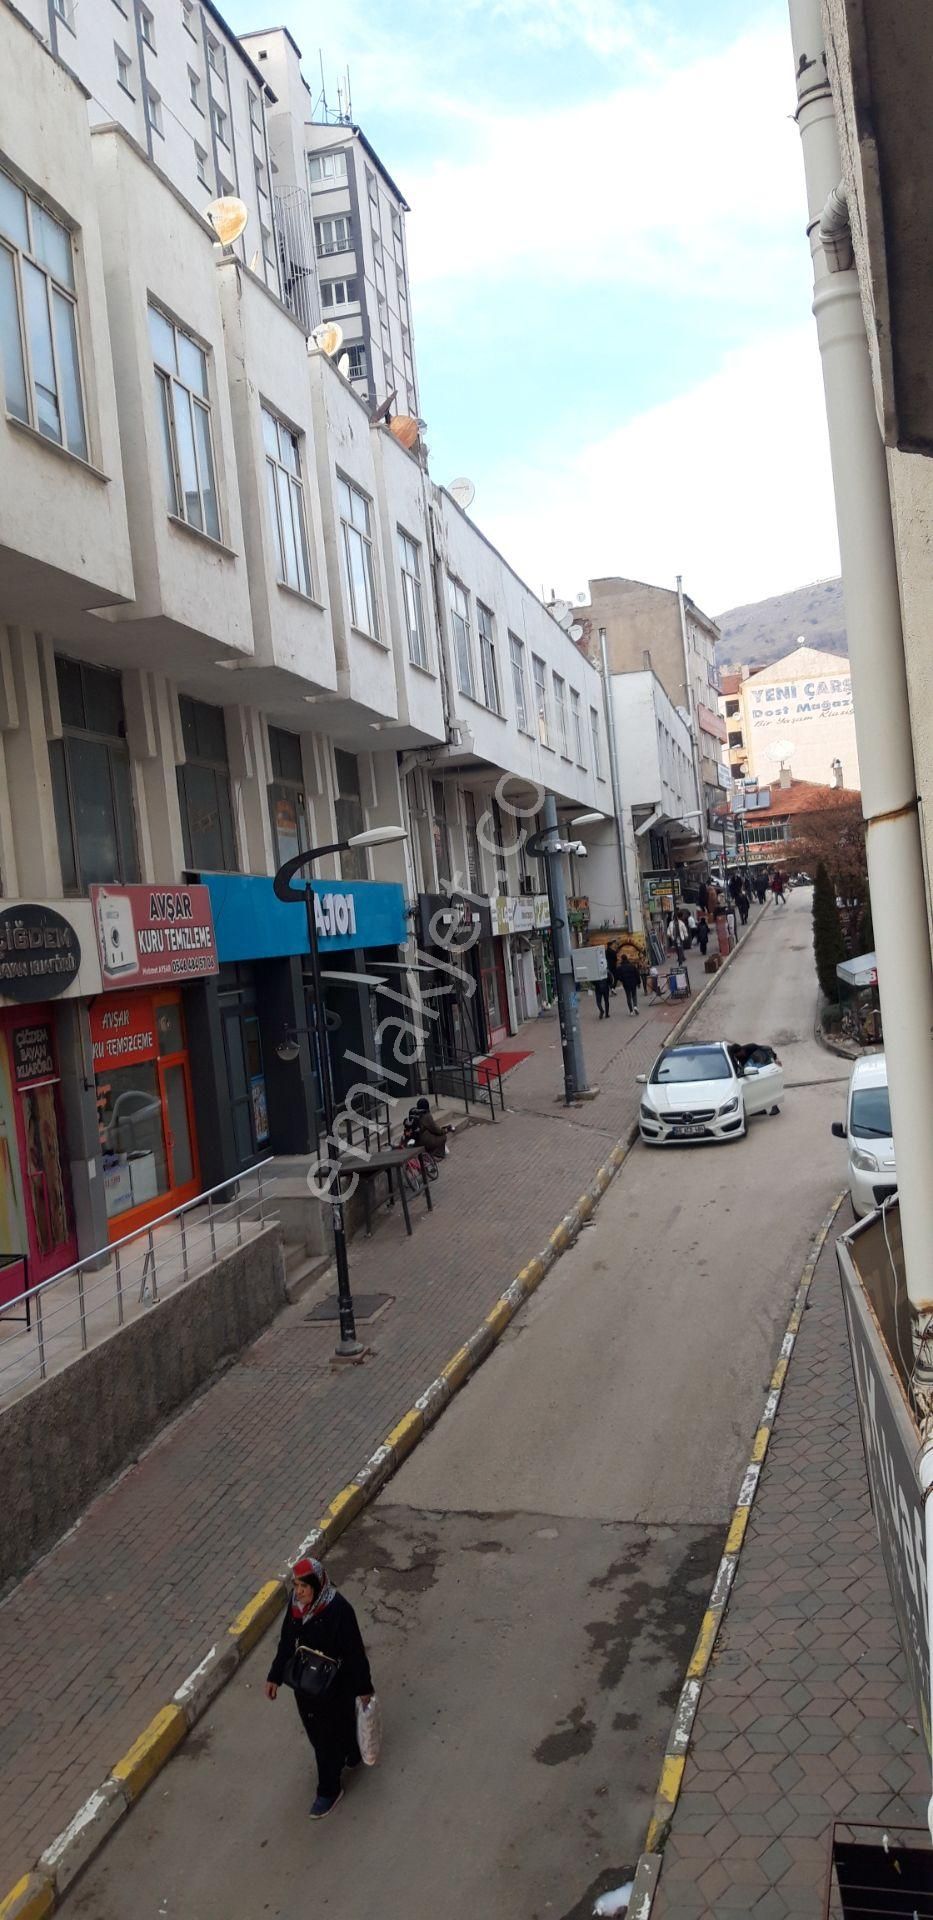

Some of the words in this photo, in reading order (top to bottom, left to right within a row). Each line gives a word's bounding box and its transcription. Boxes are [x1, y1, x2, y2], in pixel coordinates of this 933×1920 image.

[752, 706, 789, 718] Dost
[149, 892, 193, 923] AVŞAR
[138, 929, 164, 953] KURU
[165, 926, 212, 951] TEMİZLEME
[102, 1009, 130, 1032] AVŞAR
[20, 1044, 47, 1062] BAYAN
